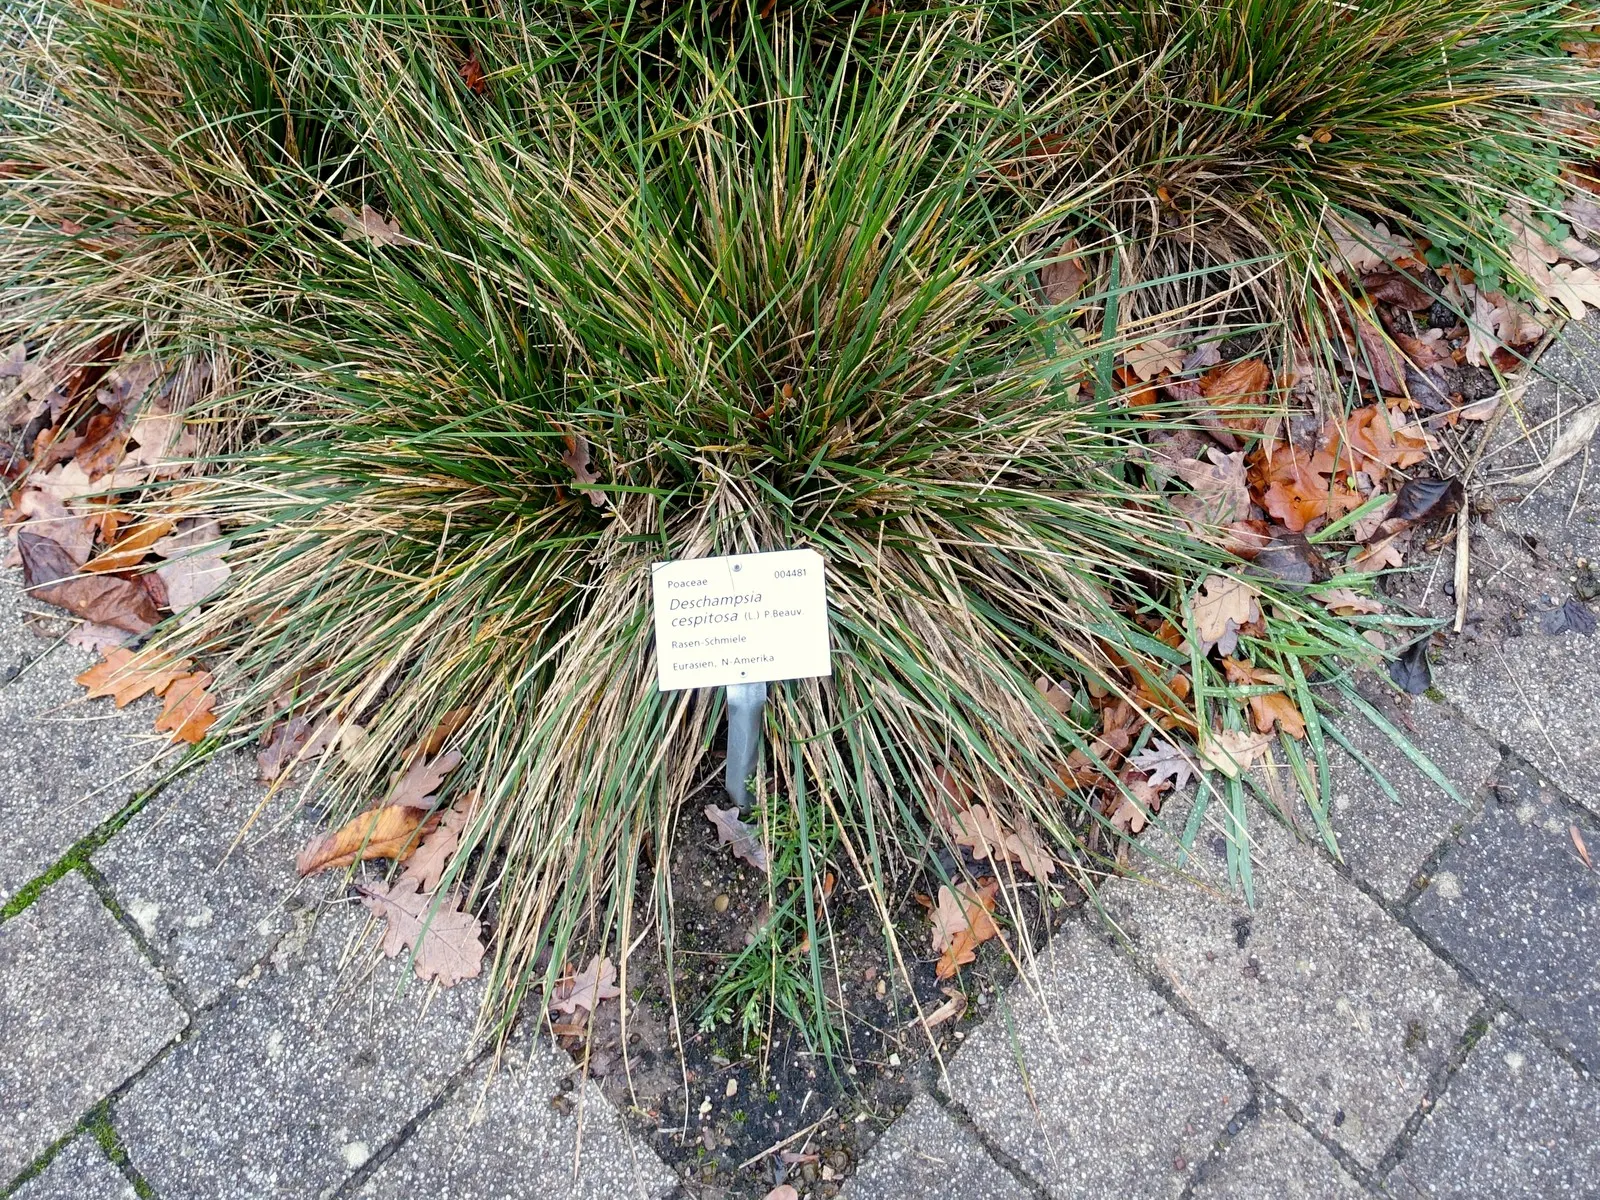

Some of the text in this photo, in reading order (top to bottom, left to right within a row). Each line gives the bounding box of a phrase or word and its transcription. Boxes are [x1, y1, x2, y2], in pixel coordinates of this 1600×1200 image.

[774, 568, 807, 579] 004481
[667, 578, 708, 589] Poaceae
[669, 590, 763, 611] Deschampsia
[671, 610, 738, 628] cespitosa
[744, 611, 760, 621] (L.)
[671, 634, 747, 649] Rasen-Schmiele
[673, 654, 775, 671] Eurasien, N-Amerika
